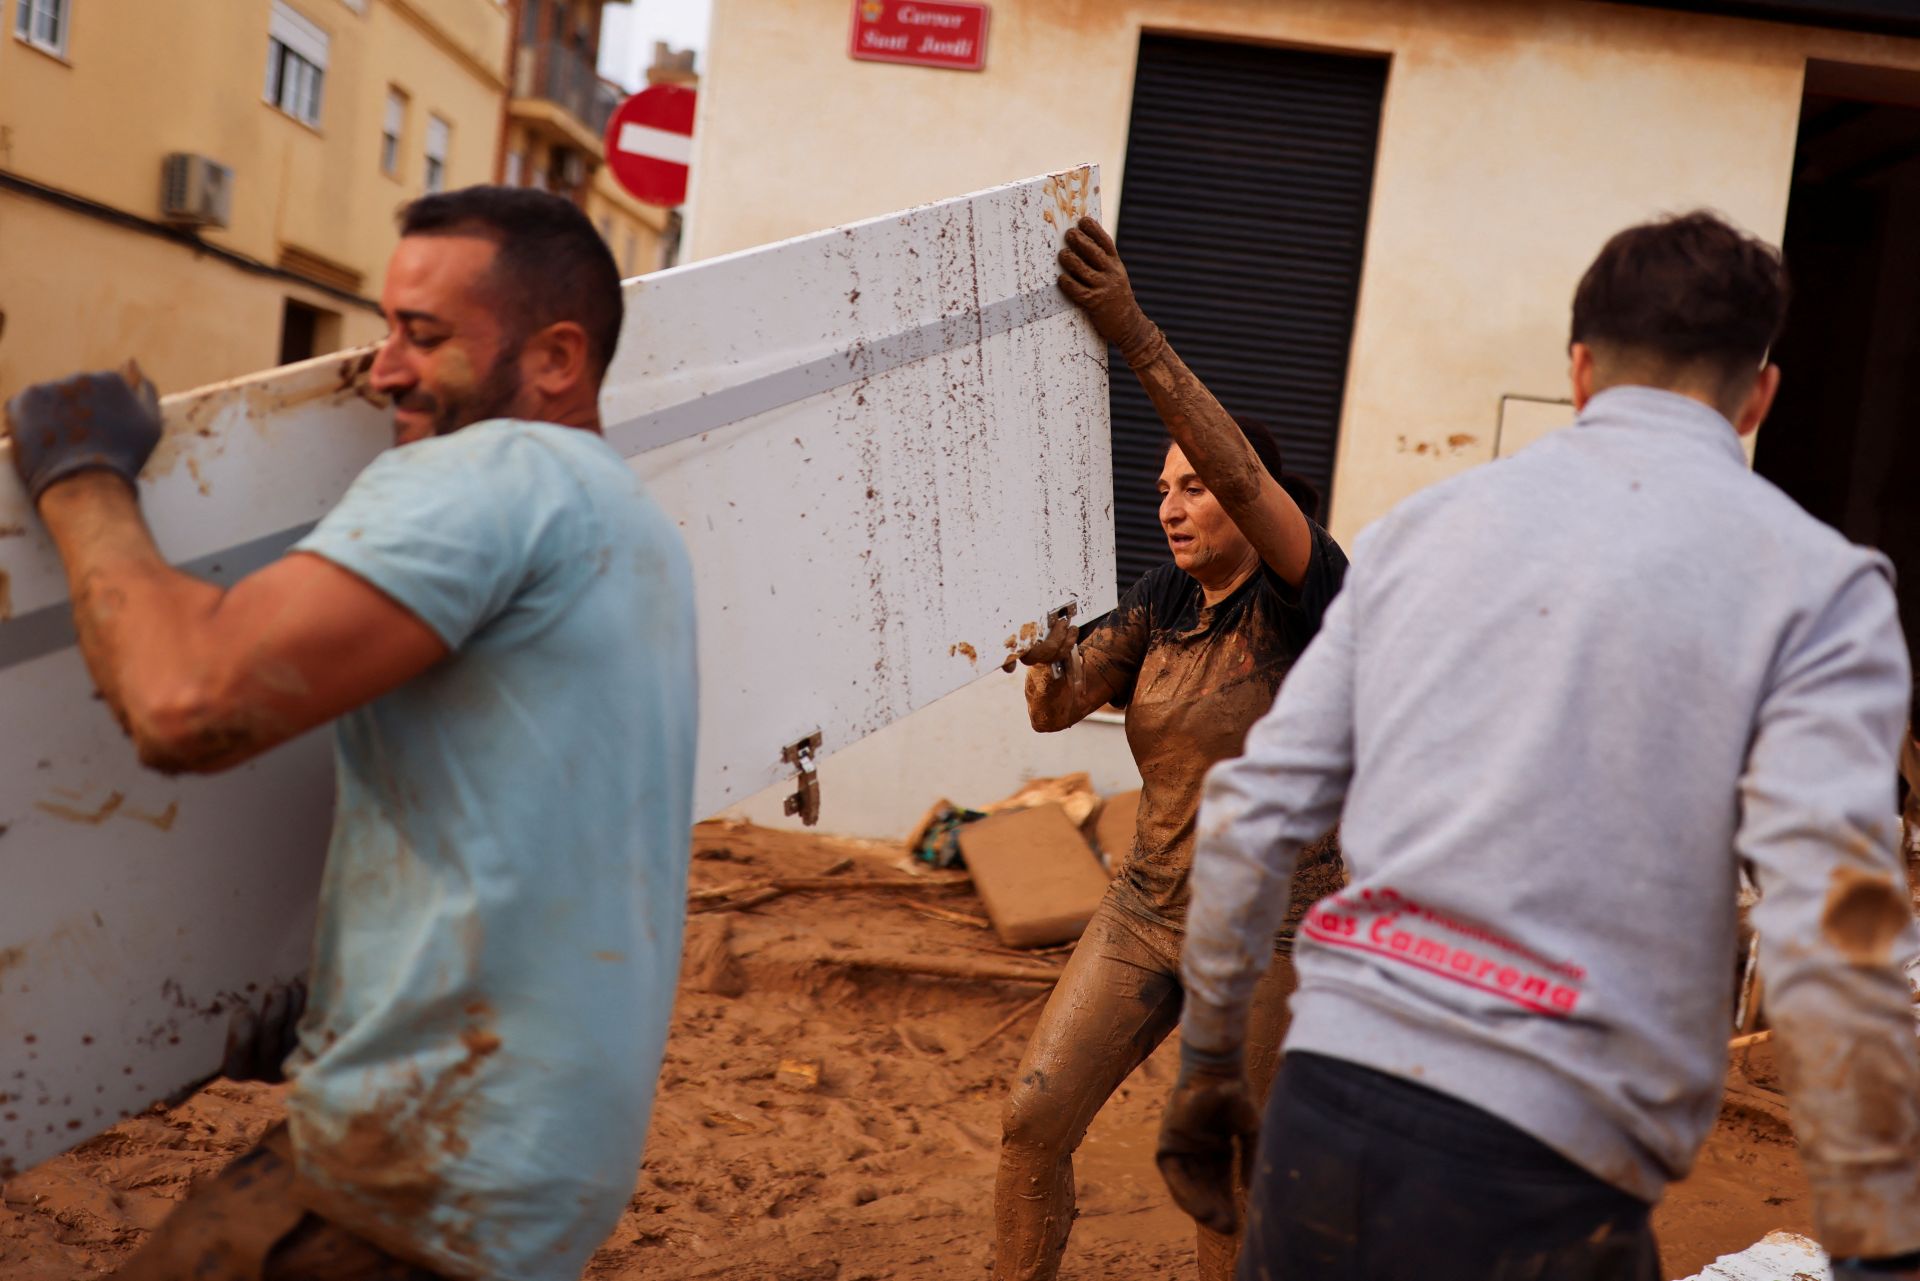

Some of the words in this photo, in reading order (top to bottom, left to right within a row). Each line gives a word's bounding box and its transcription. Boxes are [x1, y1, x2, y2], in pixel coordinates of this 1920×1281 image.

[861, 29, 908, 51] Sant
[917, 34, 972, 57] Jordi
[1369, 915, 1578, 1011] Camarena
